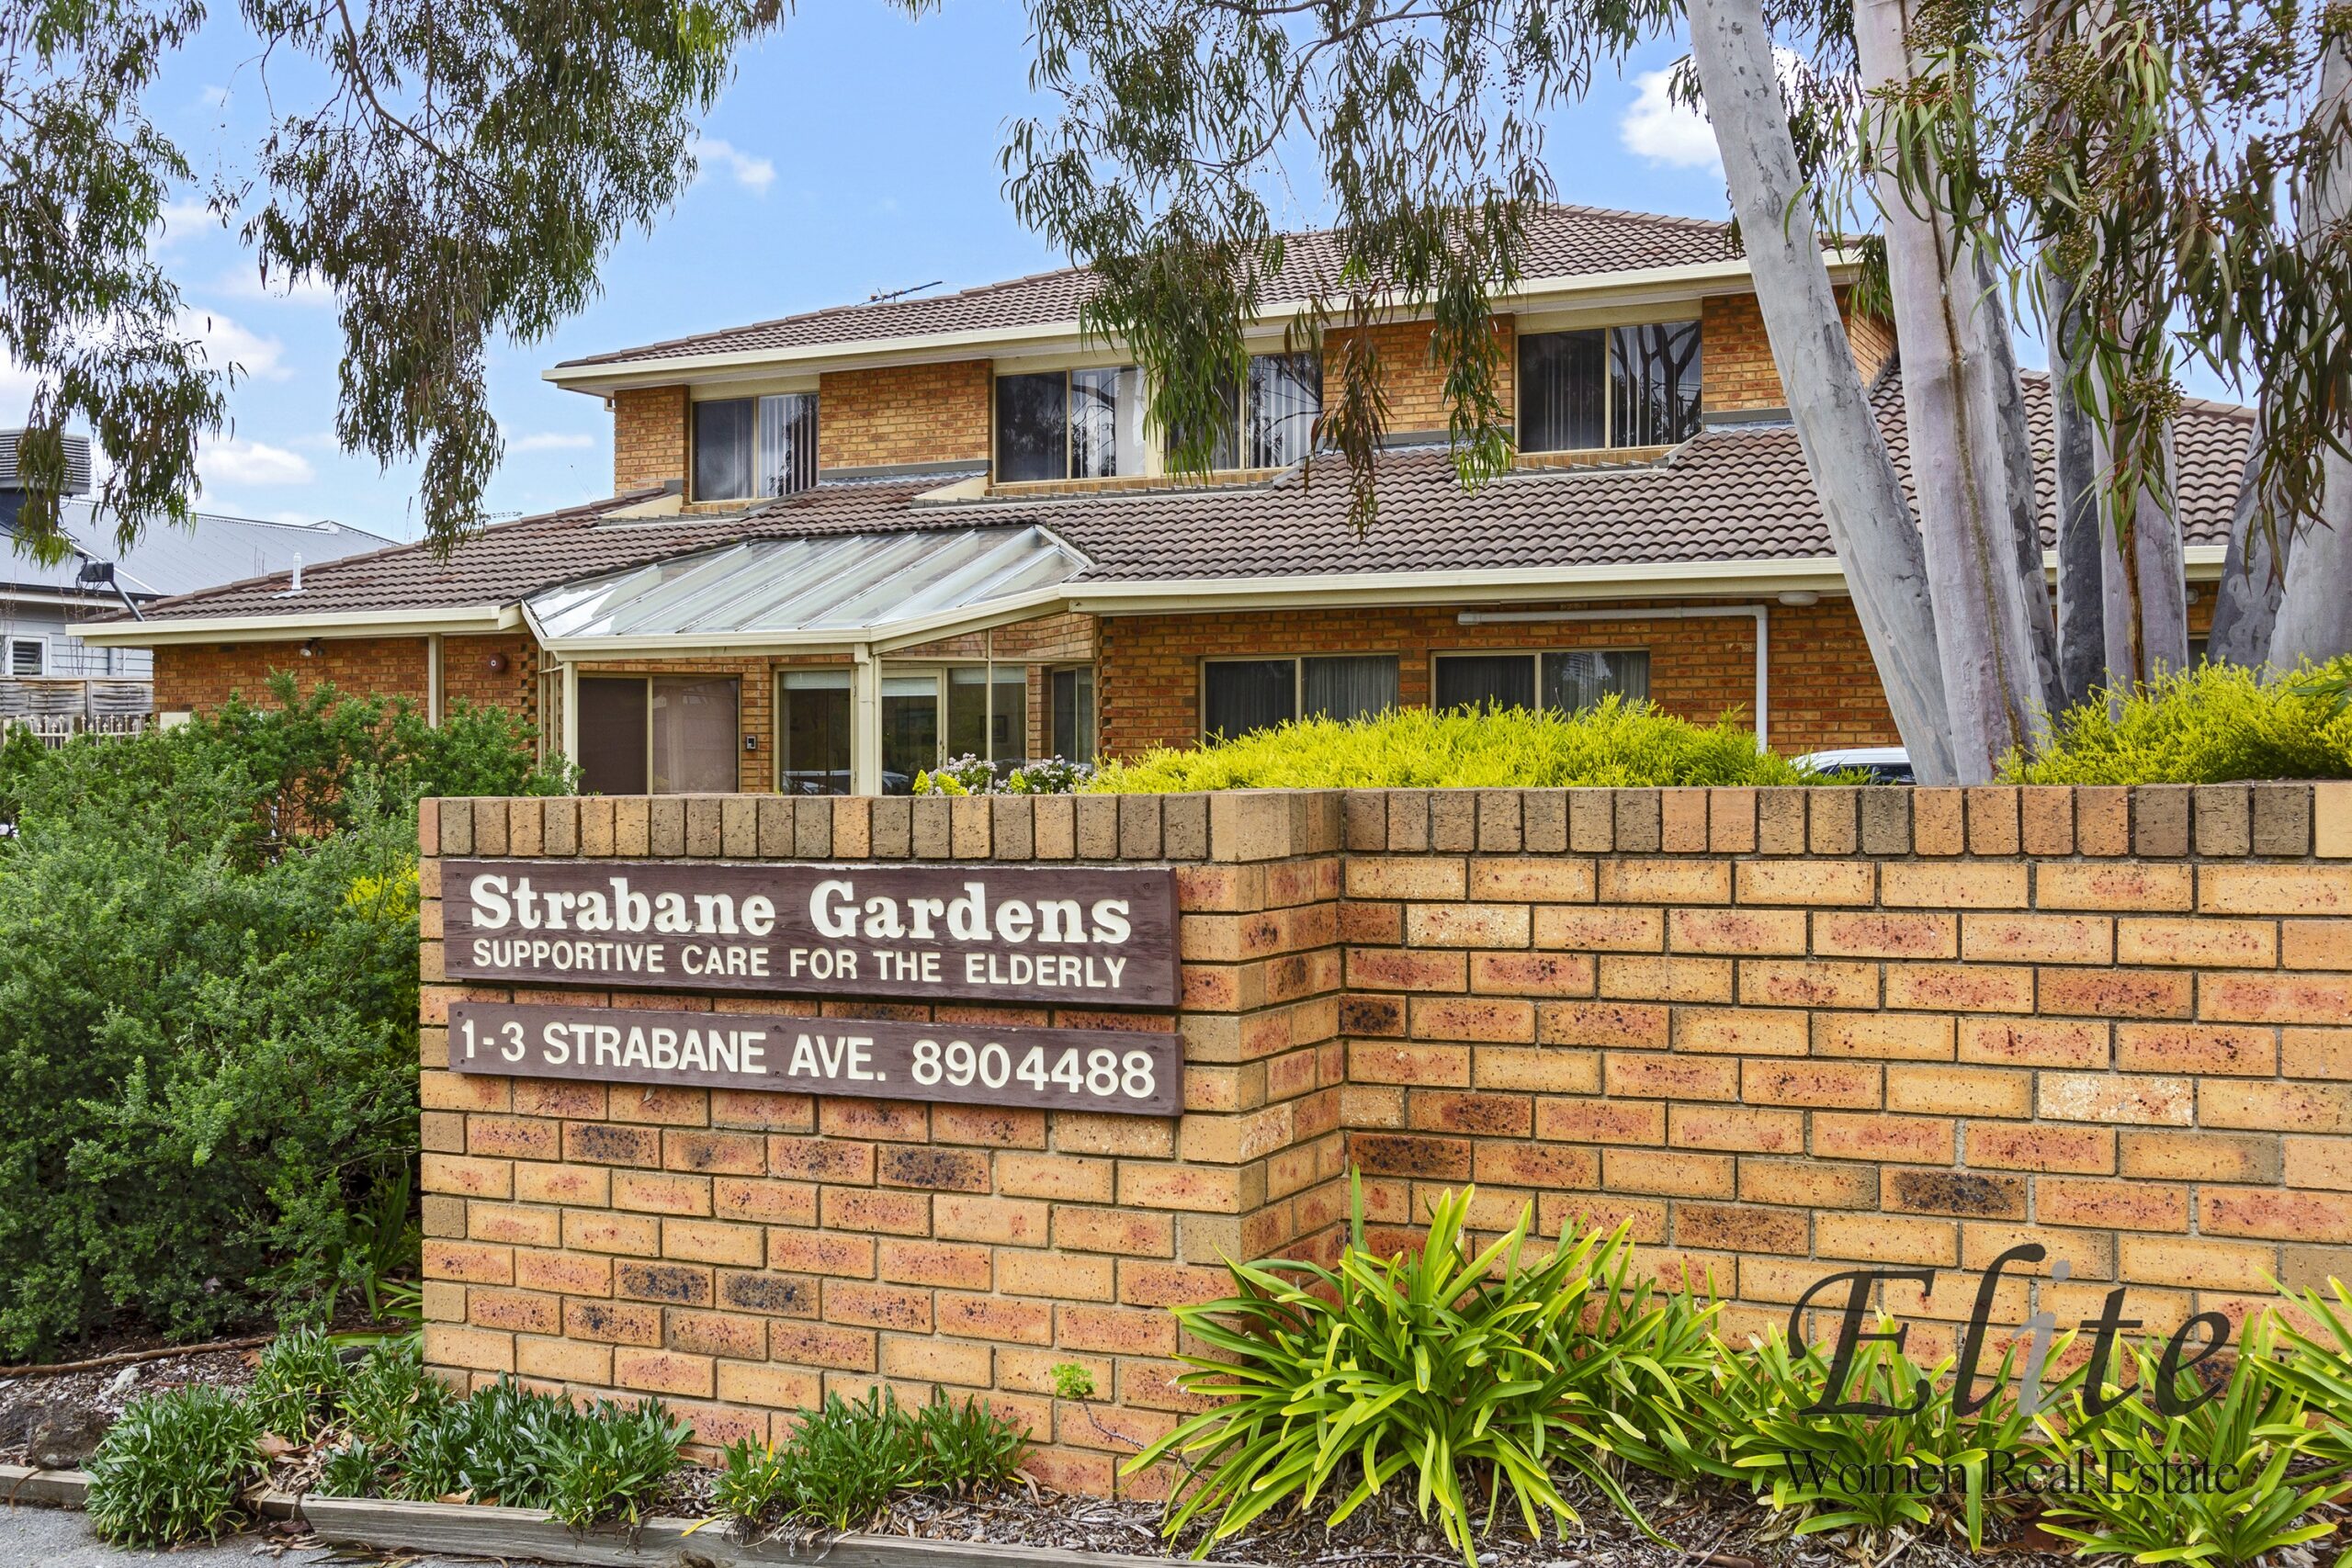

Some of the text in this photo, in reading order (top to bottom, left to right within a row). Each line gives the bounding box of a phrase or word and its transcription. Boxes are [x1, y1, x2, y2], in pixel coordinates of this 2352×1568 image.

[469, 874, 1132, 944] Strabane Gardens
[472, 938, 1127, 988] SUPPORTIVE CARE FOR THE ELDERLY
[460, 1019, 1156, 1099] 1-3 STRABANE AVE. 8904488
